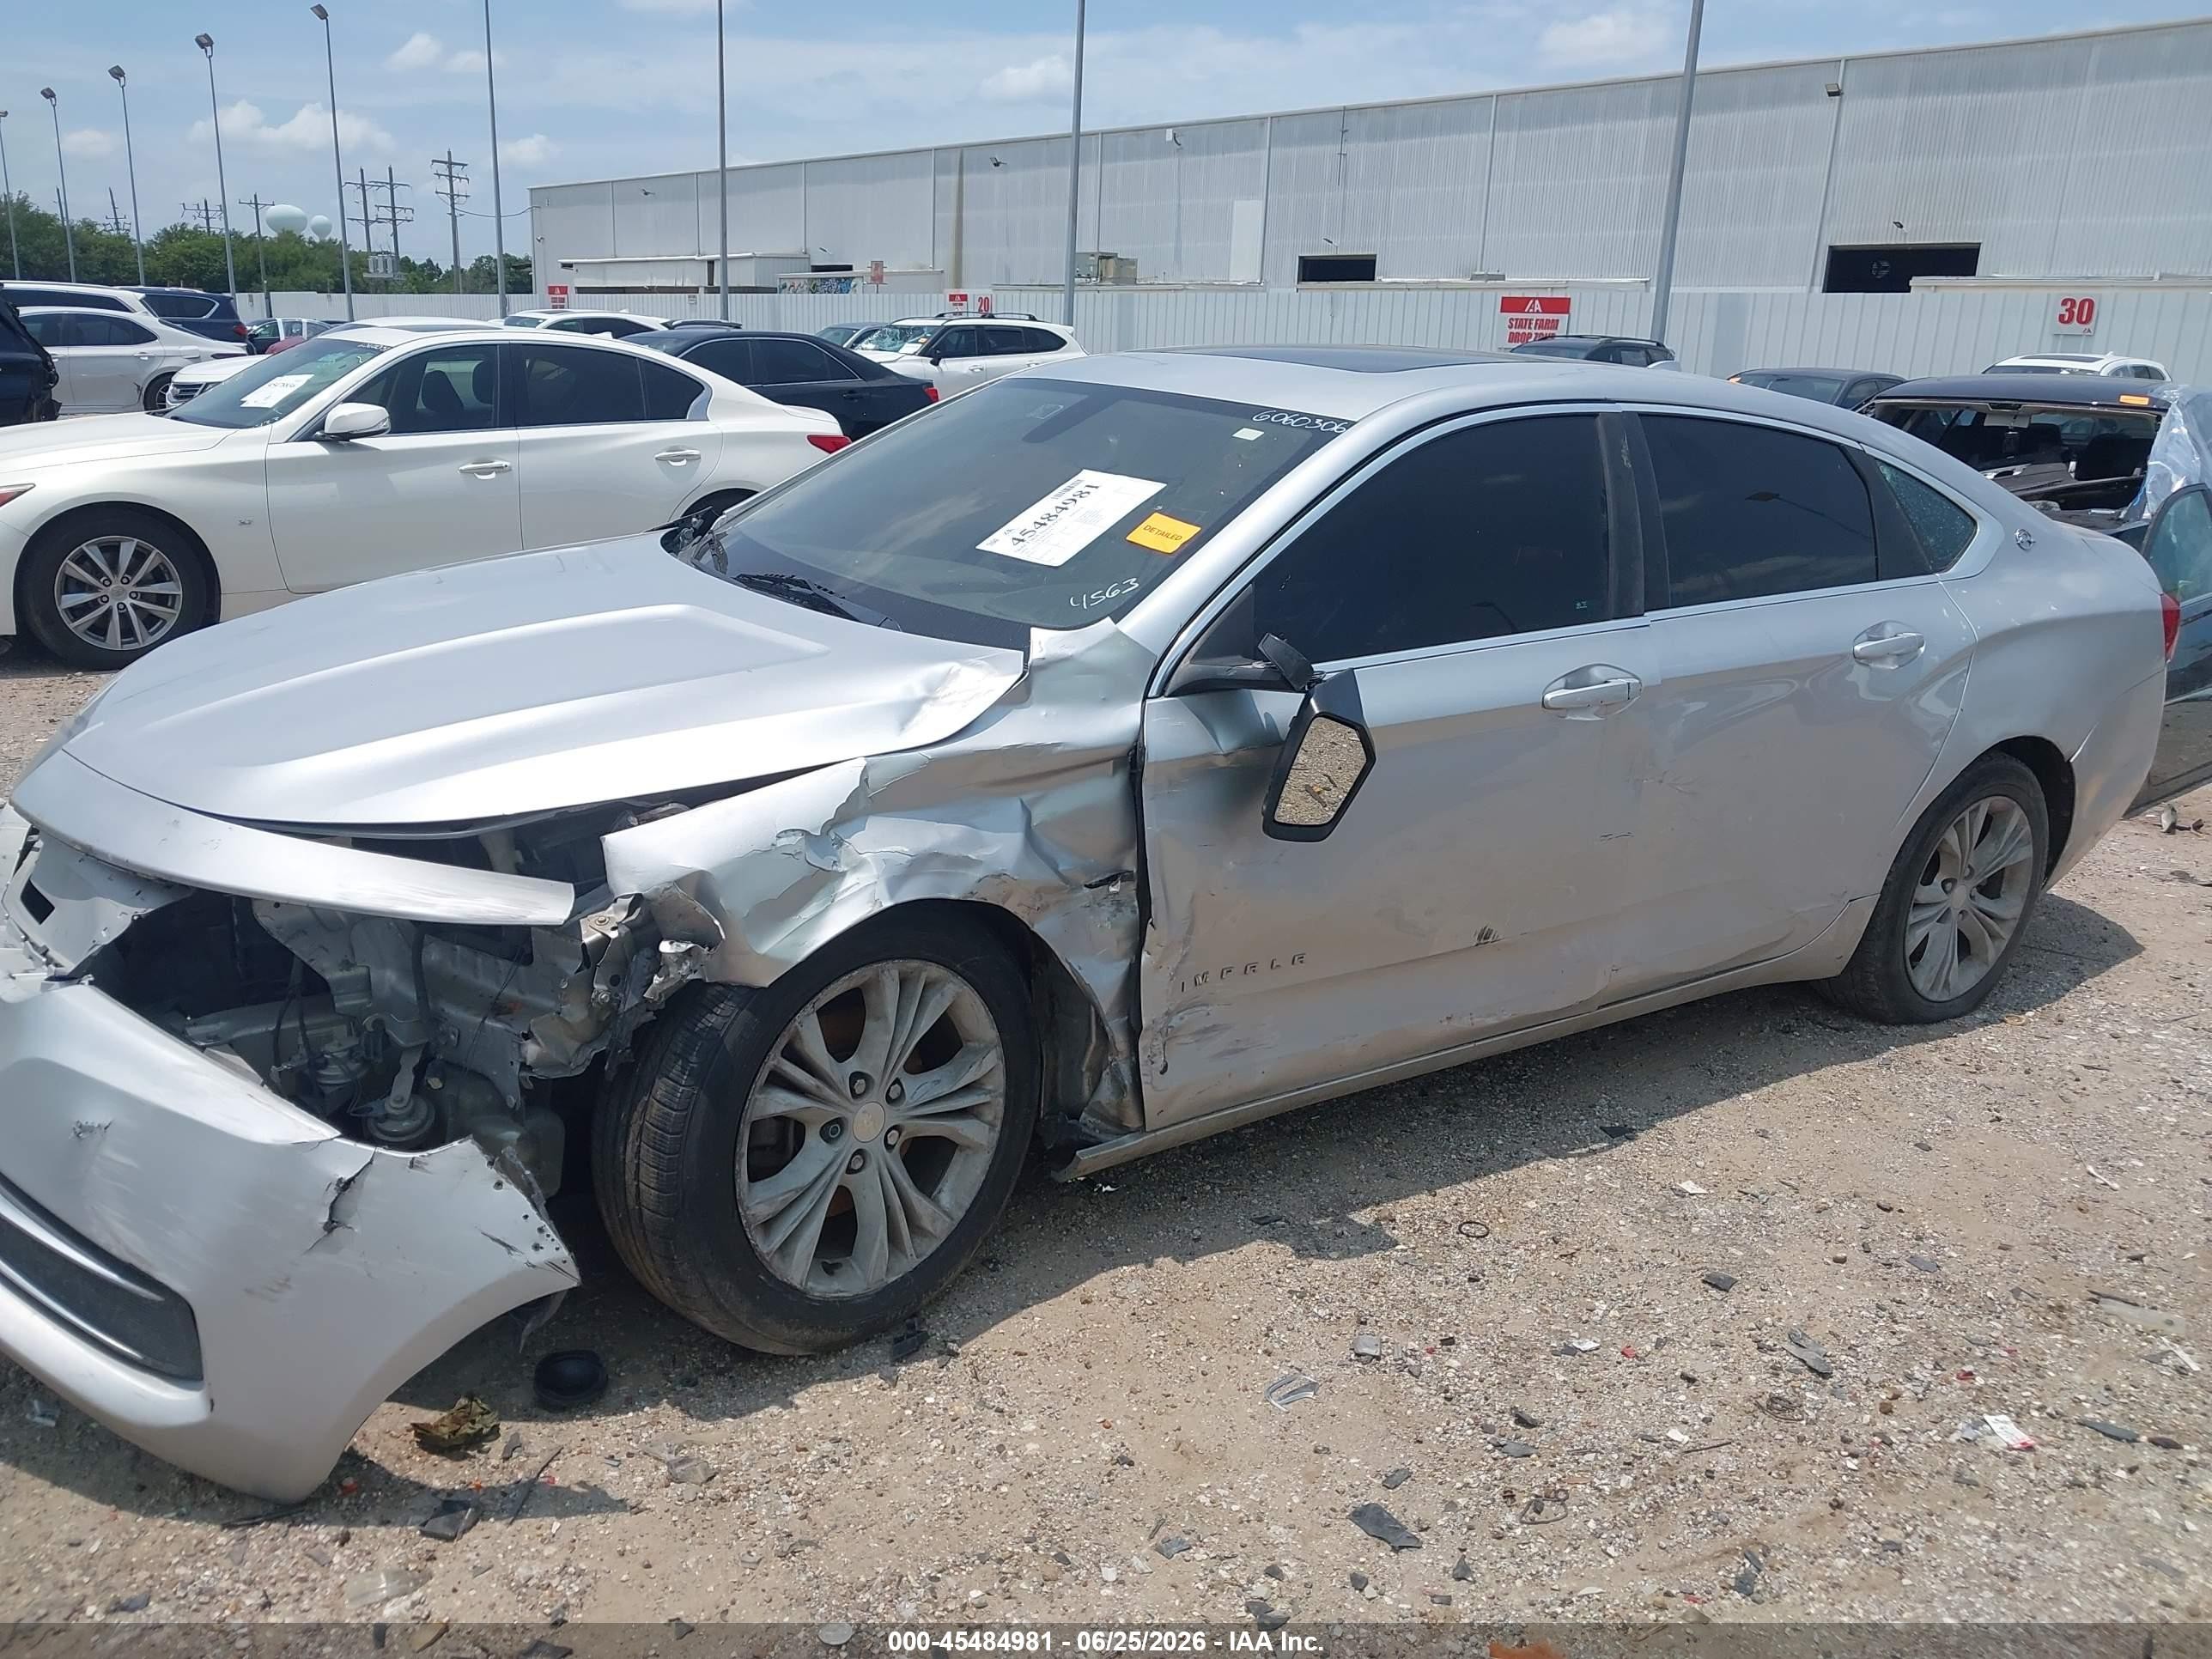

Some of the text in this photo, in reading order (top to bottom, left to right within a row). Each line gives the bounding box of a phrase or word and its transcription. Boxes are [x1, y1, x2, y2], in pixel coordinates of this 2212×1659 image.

[977, 296, 990, 313] 20
[2058, 297, 2095, 325] 30
[1508, 318, 1559, 331] STATE FARM
[1508, 331, 1533, 344] DROP
[1252, 410, 1349, 434] 6060306
[1012, 483, 1101, 547] 45484981
[1143, 524, 1182, 541] DETAILED
[1069, 577, 1139, 610] 4563
